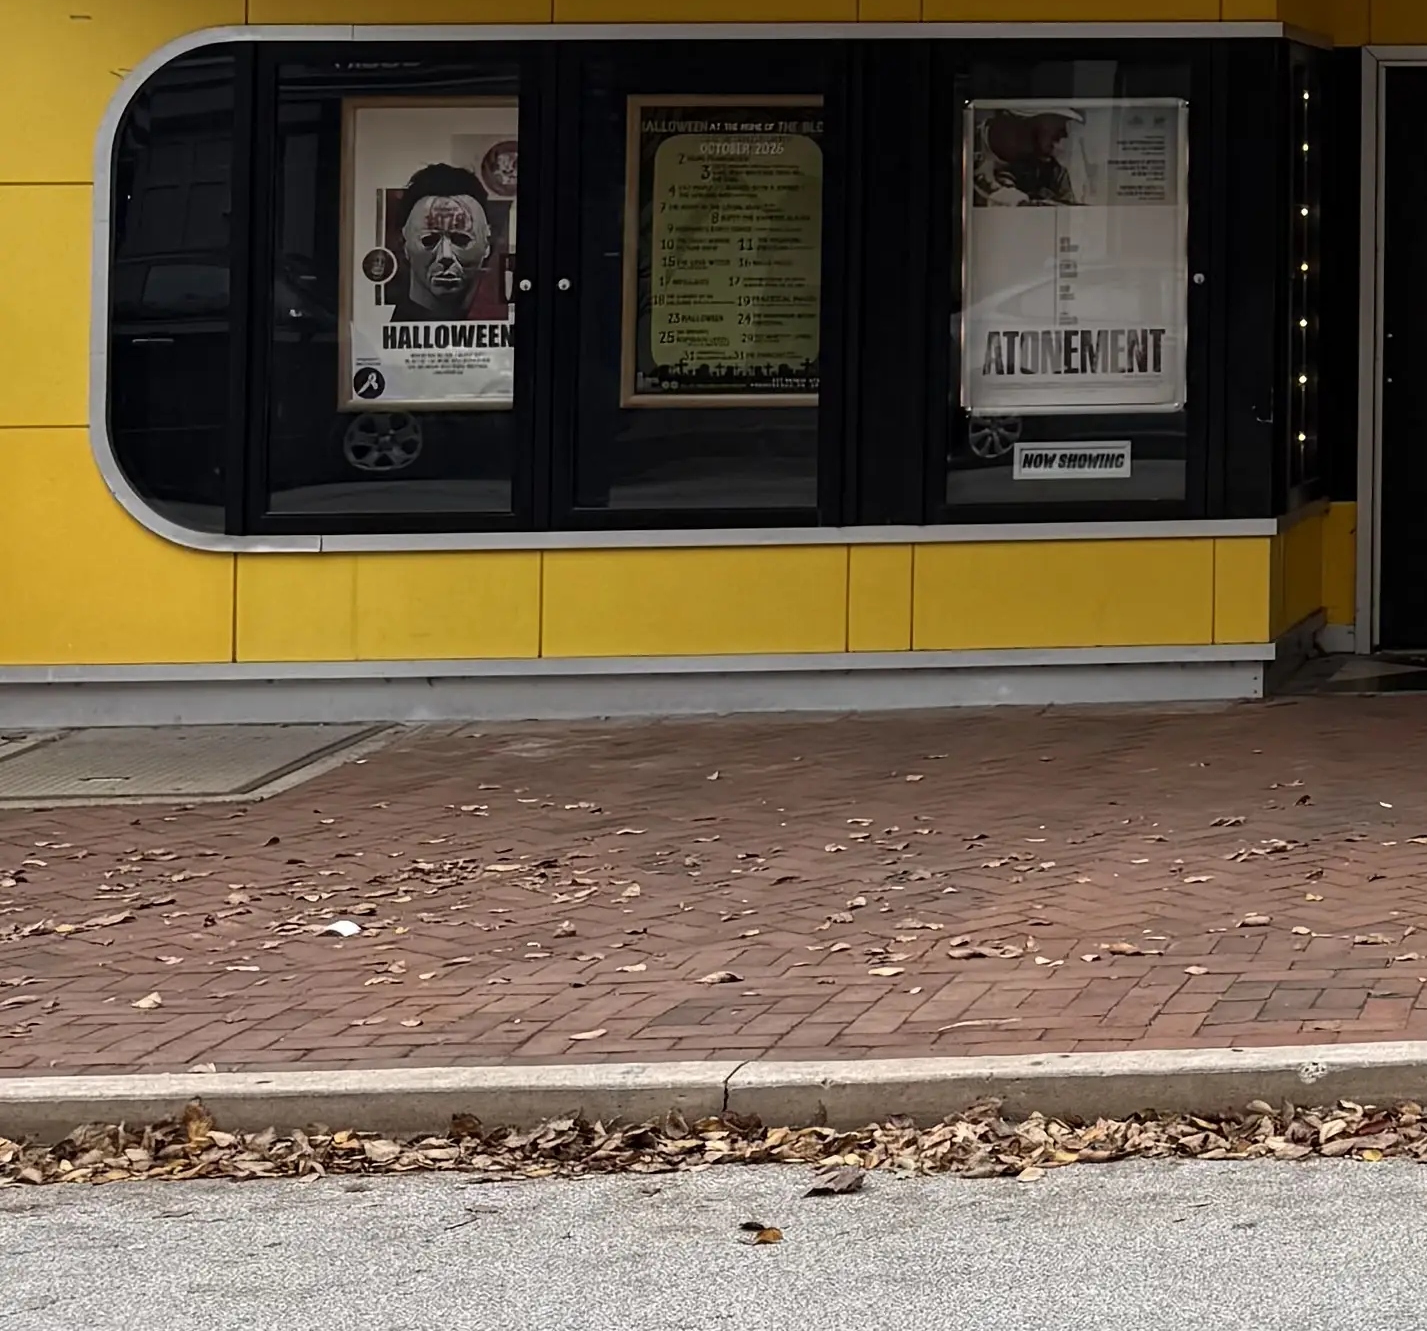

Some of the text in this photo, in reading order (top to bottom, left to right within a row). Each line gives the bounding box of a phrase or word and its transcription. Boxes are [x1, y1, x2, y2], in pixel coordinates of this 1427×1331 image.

[700, 165, 711, 180] 3
[661, 239, 674, 250] 10
[738, 239, 753, 250] 11
[662, 256, 676, 267] 15
[382, 323, 516, 349] HALLOWEEN
[659, 331, 675, 344] 25
[982, 328, 1166, 376] ATONEMENT
[1022, 452, 1125, 469] NOW SHOWING
